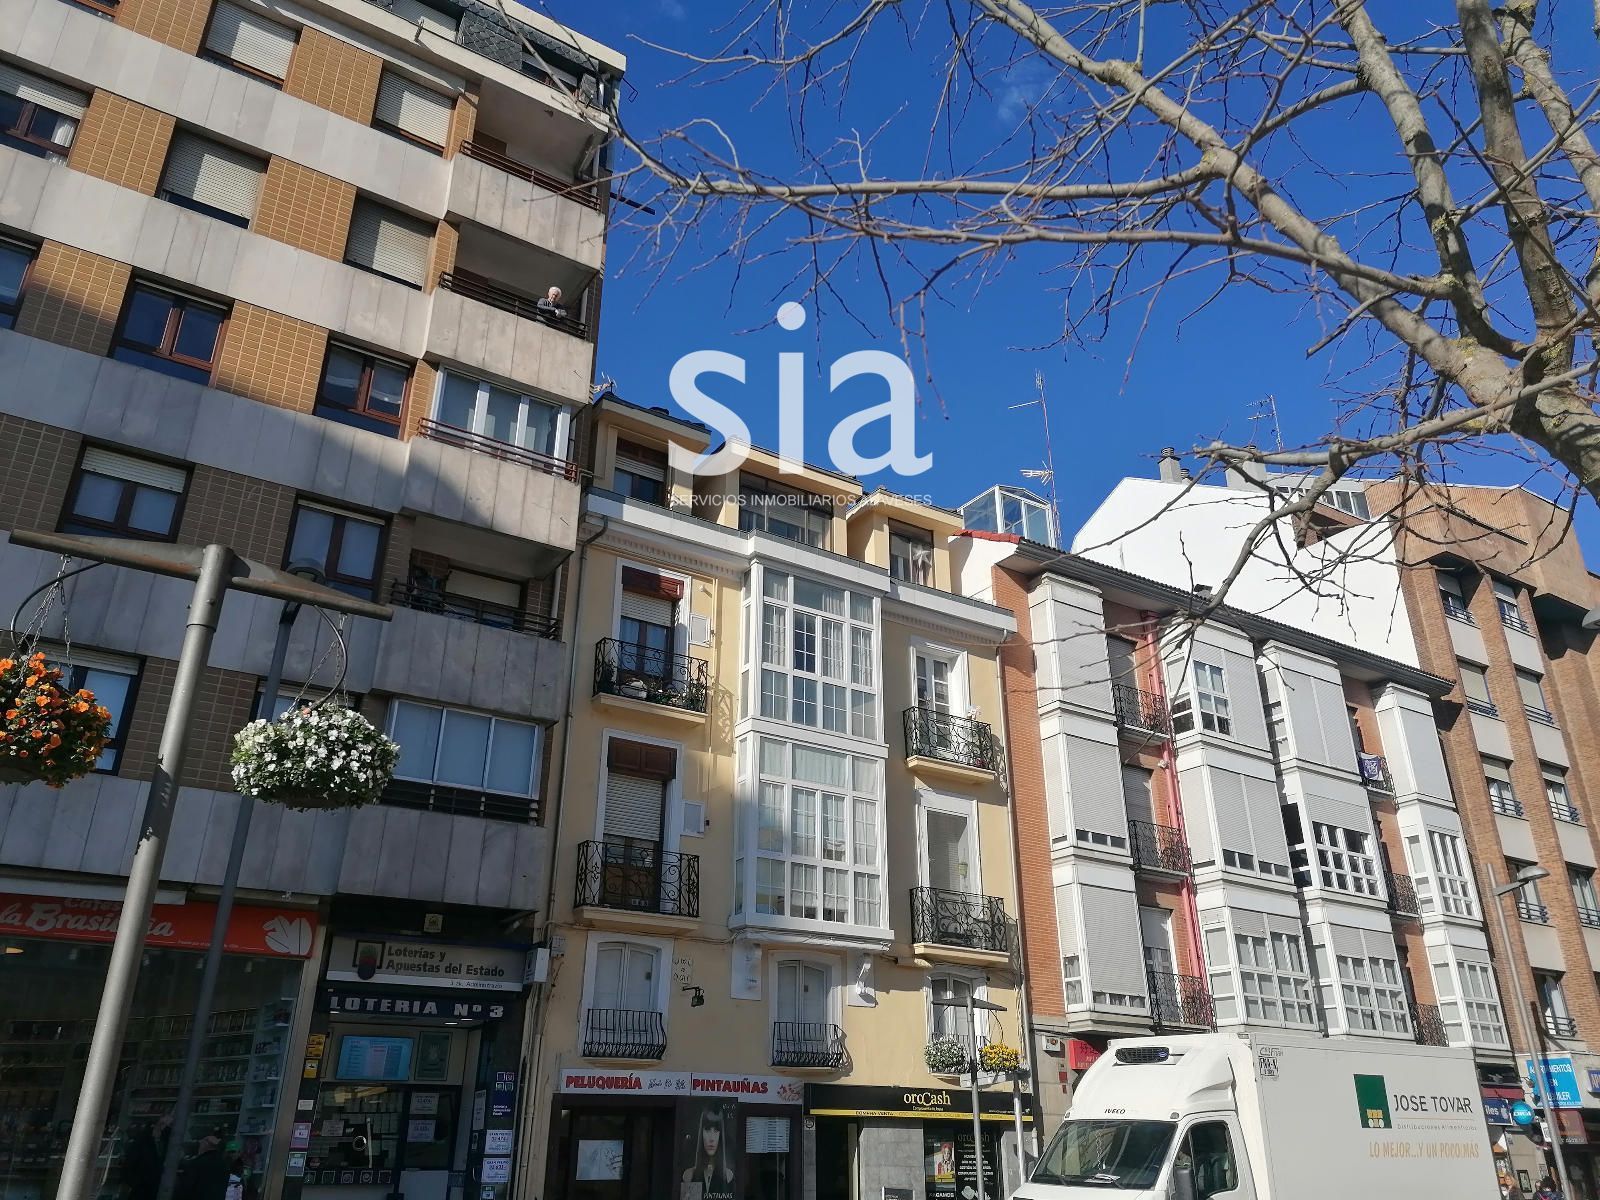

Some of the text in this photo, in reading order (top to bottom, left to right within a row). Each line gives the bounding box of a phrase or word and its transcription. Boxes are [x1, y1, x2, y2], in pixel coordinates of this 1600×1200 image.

[387, 946, 447, 962] Loterías y
[386, 960, 505, 977] Apuestas del Estado
[329, 996, 438, 1015] LOTERIA
[489, 1005, 504, 1018] 3
[565, 1073, 642, 1090] PELUQUERÍA
[692, 1077, 769, 1094] PINTAUÑAS
[903, 1091, 951, 1106] oroCash
[1393, 1094, 1473, 1113] JOSE TOVAR
[1369, 1141, 1380, 1159] LO
[1426, 1142, 1438, 1159] UN
